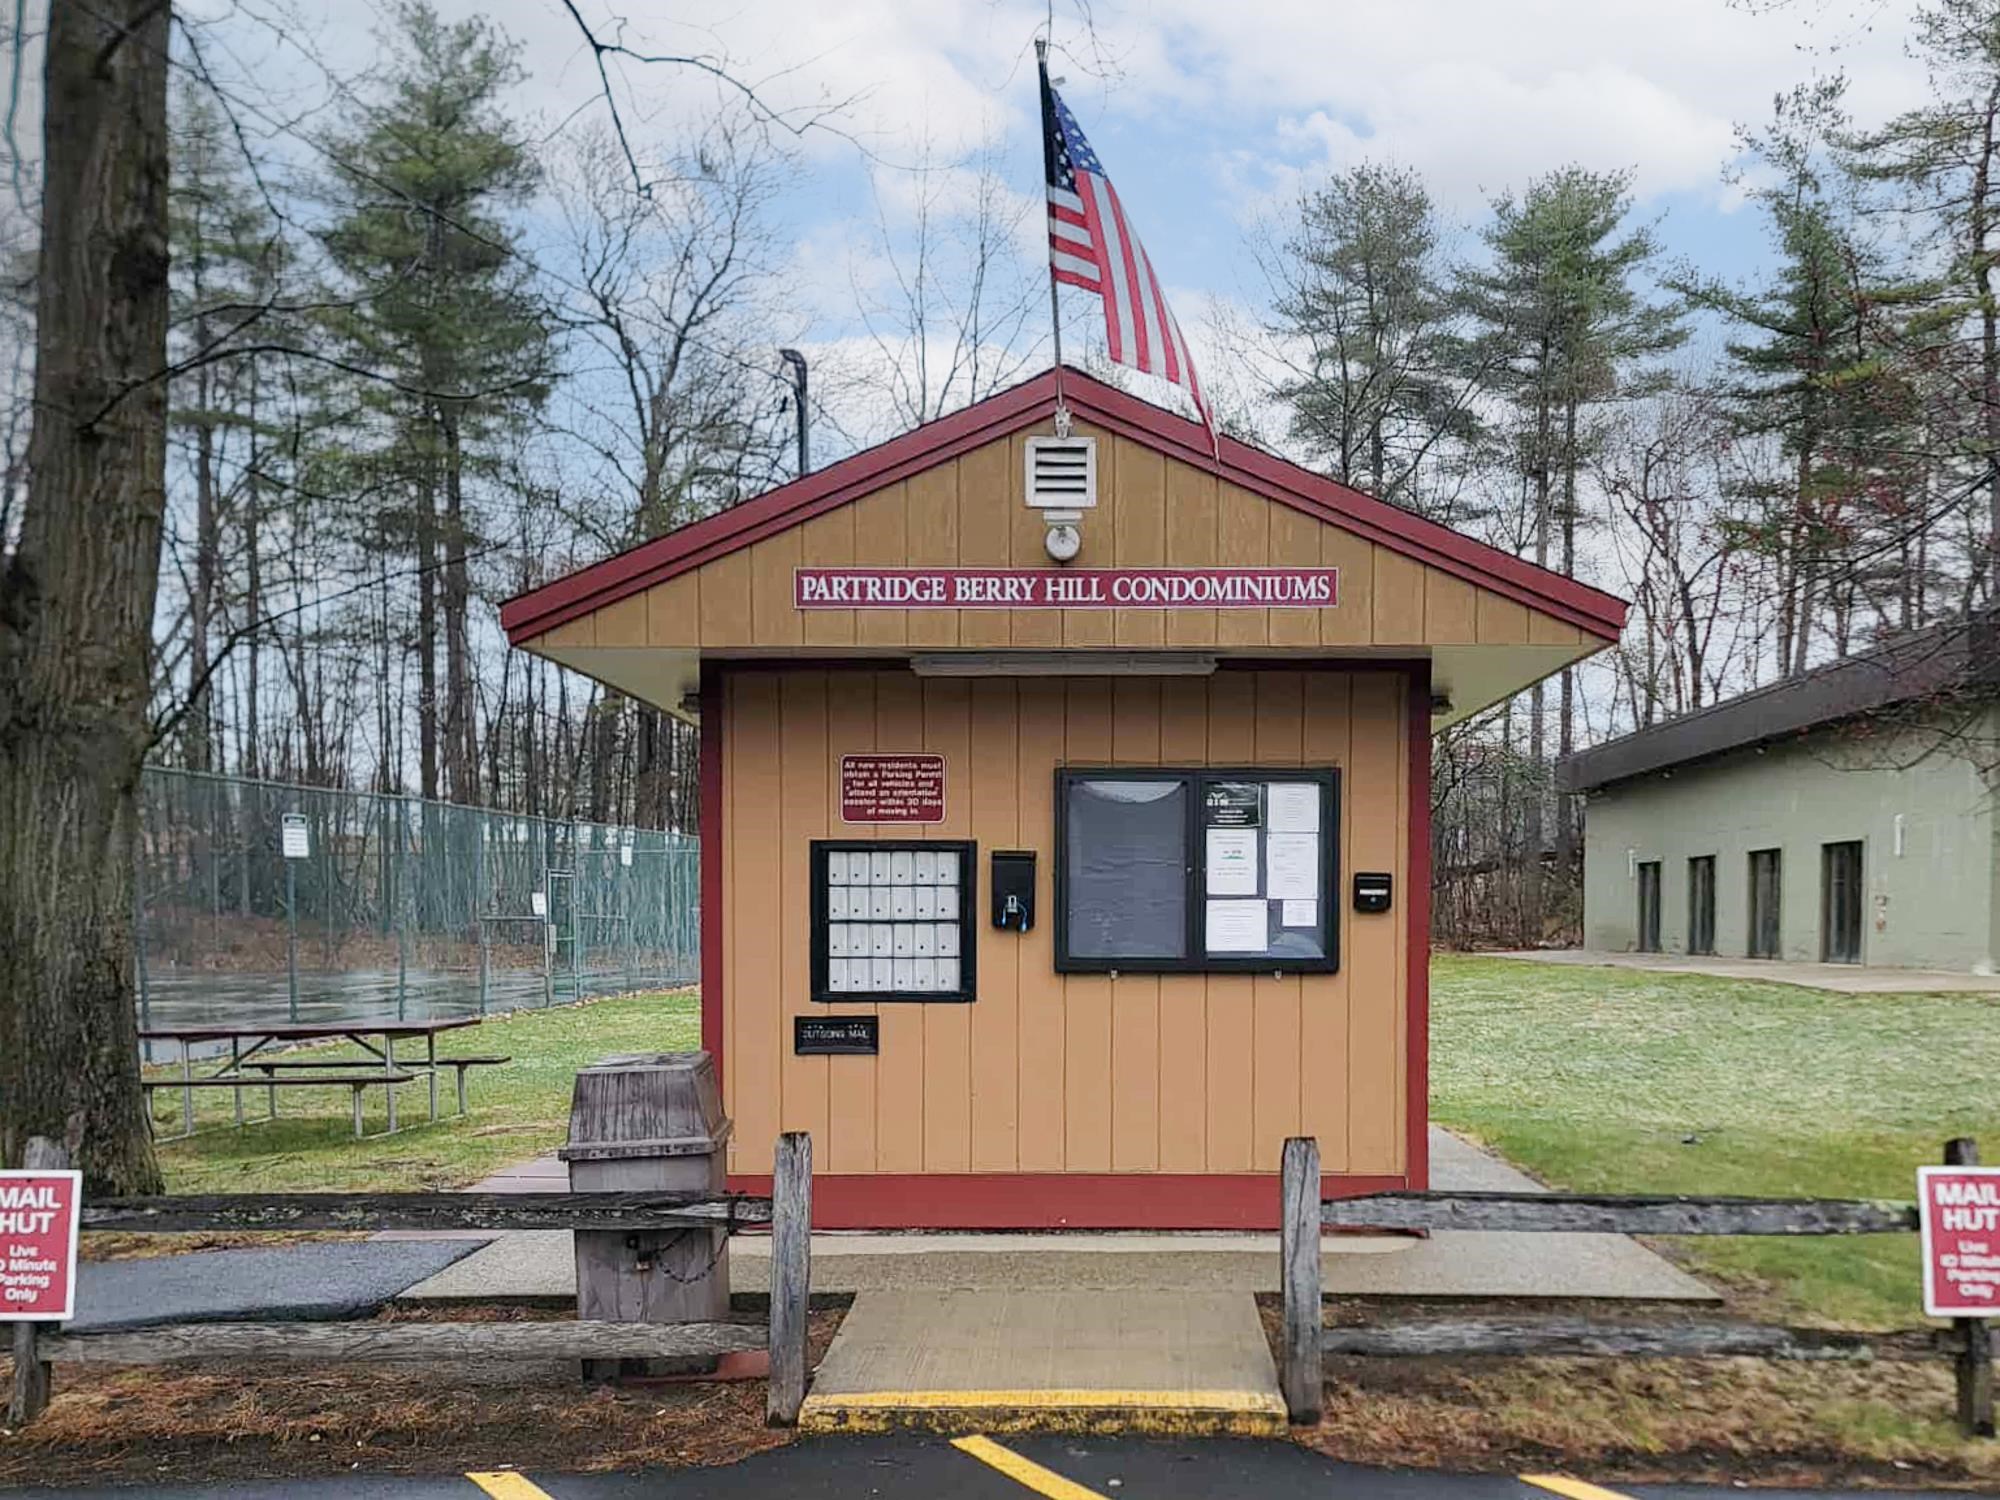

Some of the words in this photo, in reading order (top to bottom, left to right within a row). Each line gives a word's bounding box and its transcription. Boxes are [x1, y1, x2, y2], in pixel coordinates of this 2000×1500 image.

[801, 575, 947, 601] PARTRIDGE
[953, 577, 1037, 601] BERRY
[1045, 577, 1106, 601] HILL
[1112, 575, 1330, 601] CONDOMINIUMS
[881, 770, 913, 780] Parking
[0, 1186, 62, 1209] MAIL
[1935, 1182, 2000, 1206] MAIL
[0, 1211, 56, 1234] HUT
[1942, 1207, 2000, 1232] HUT
[9, 1244, 38, 1257] Live
[10, 1258, 57, 1272] Minute
[5, 1287, 38, 1303] Only
